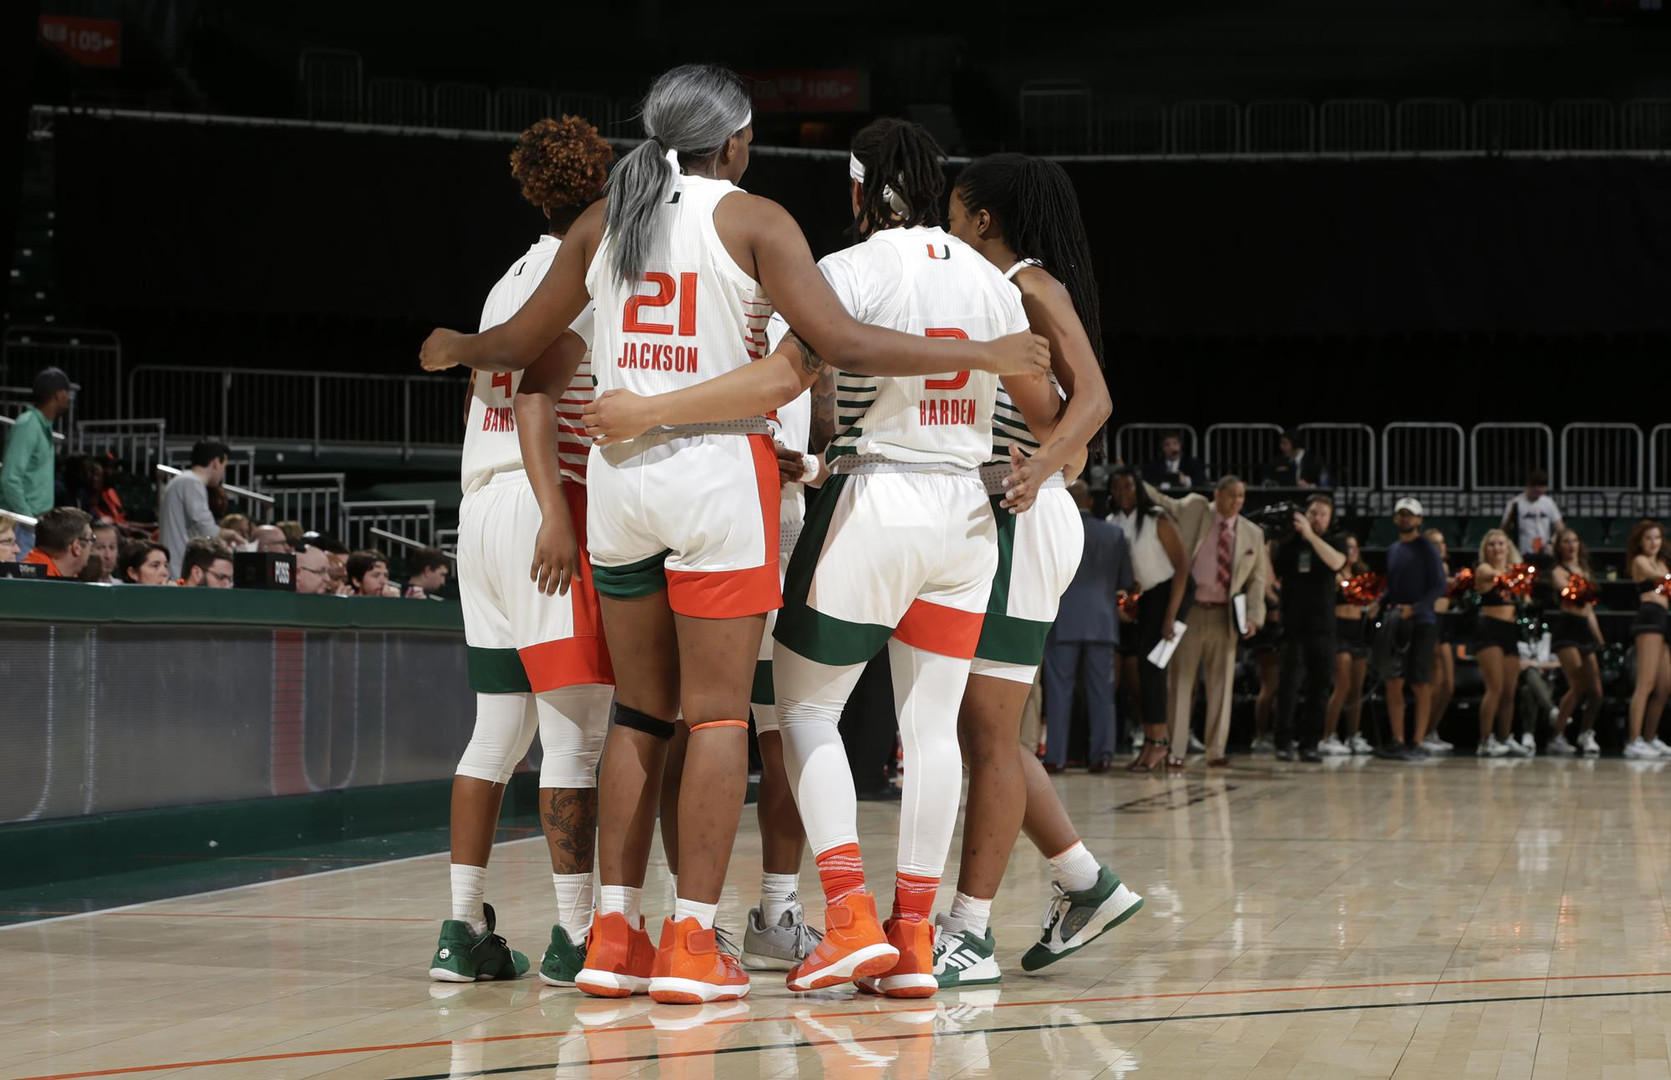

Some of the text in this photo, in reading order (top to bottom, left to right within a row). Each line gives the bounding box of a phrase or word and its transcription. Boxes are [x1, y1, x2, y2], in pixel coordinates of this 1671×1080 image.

[926, 244, 951, 261] U
[622, 271, 698, 337] 21
[617, 341, 699, 374] JACKSON
[491, 371, 512, 399] 4
[482, 406, 515, 433] BANKS
[919, 398, 976, 427] HARDEN
